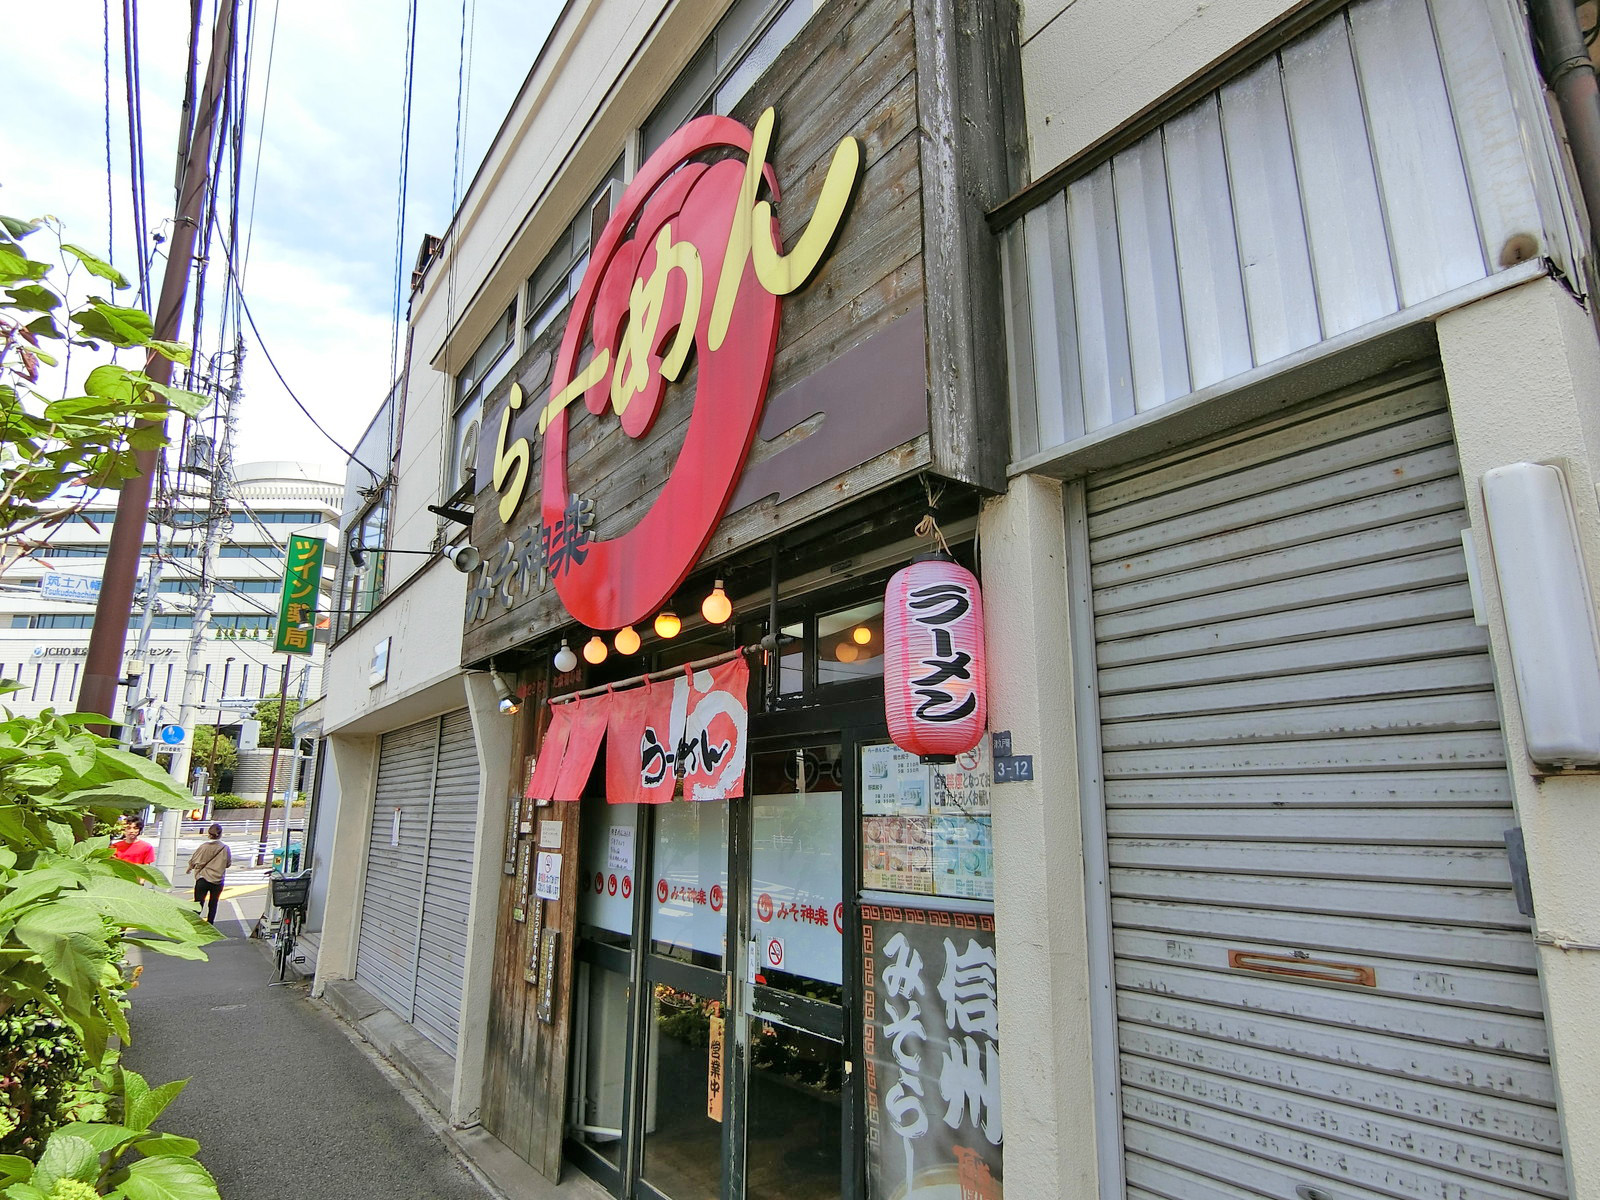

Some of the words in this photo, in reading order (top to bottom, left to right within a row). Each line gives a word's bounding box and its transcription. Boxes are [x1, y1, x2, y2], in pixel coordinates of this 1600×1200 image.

[493, 106, 861, 523] らーめん
[465, 493, 596, 624] みそ神楽
[283, 540, 320, 650] ツイン薬局
[44, 647, 71, 657] JCHO
[908, 583, 977, 723] ラーメン
[640, 728, 730, 786] らーめん
[998, 761, 1028, 776] 3-12
[670, 885, 706, 906] みそ神楽
[776, 901, 829, 927] みそ神楽
[710, 1040, 721, 1099] 営業中
